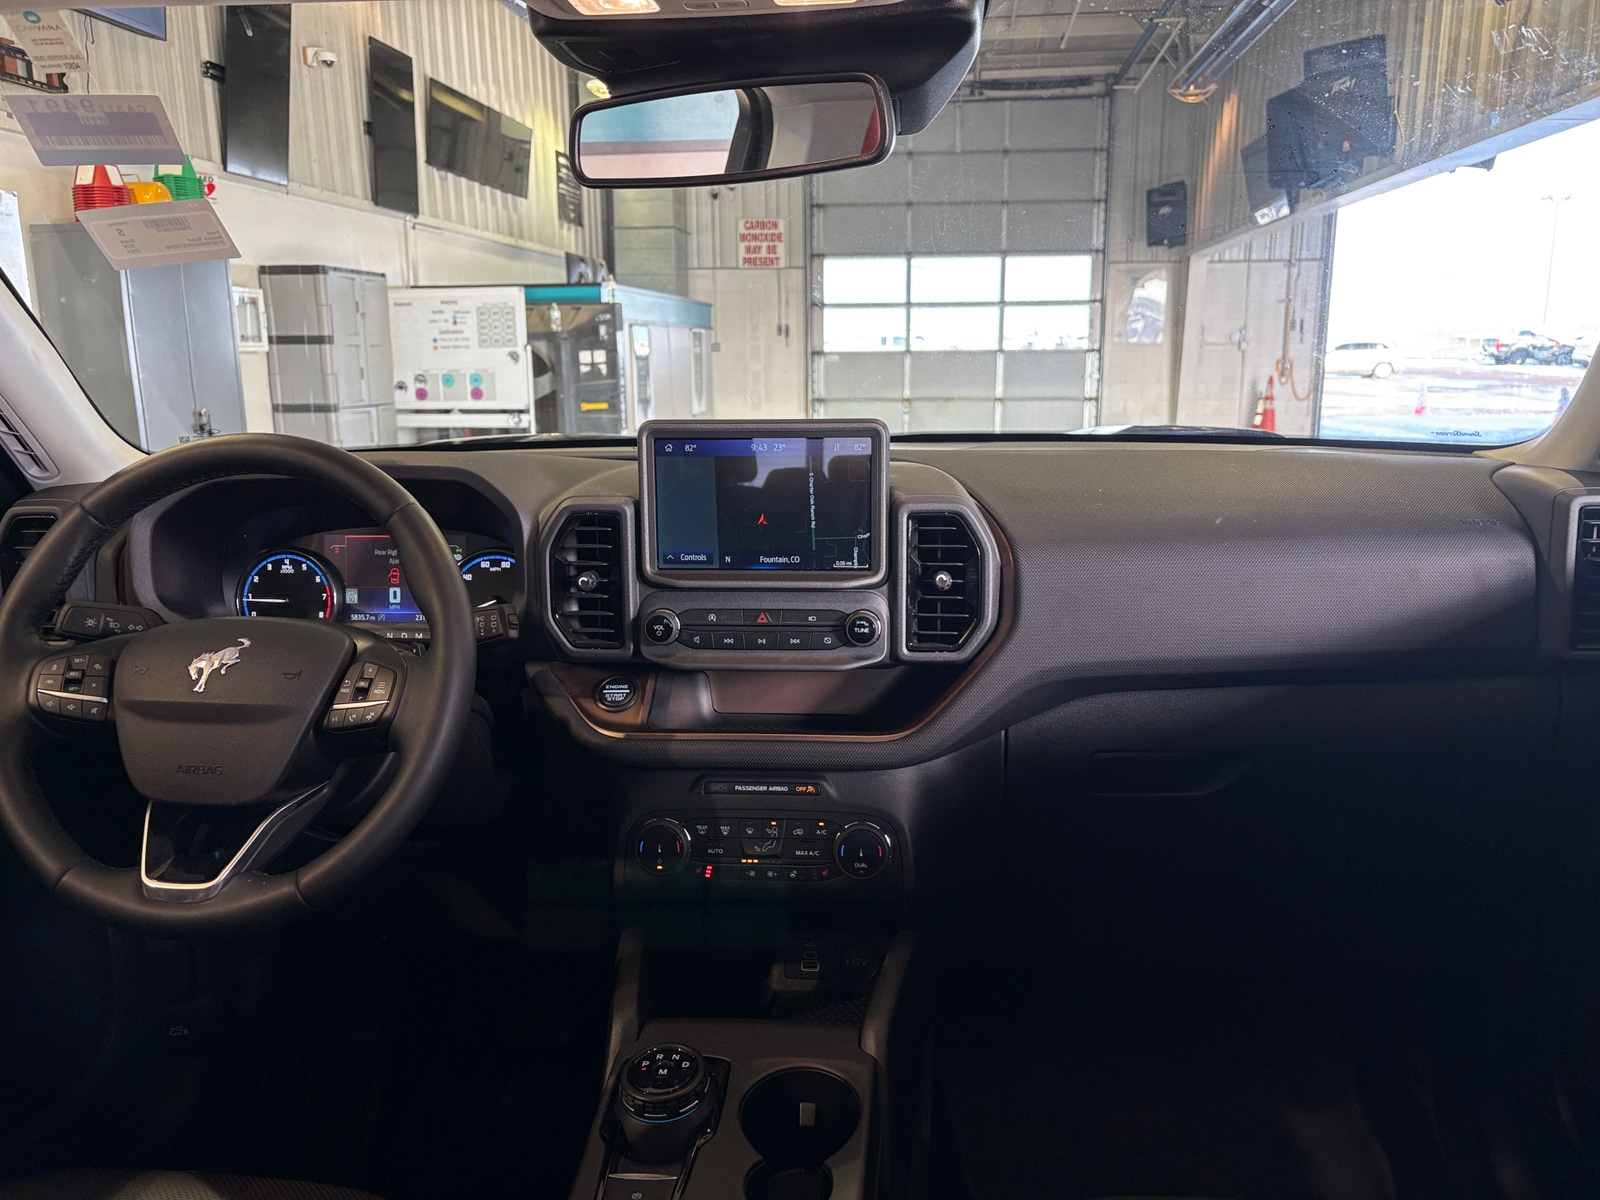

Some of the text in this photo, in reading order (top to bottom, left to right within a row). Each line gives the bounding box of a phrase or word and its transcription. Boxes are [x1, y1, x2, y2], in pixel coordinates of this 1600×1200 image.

[743, 220, 779, 231] CARBON
[739, 232, 783, 243] MONOXIDE
[744, 244, 778, 255] MAY BE
[742, 256, 780, 267] PRESENT
[751, 444, 768, 452] 9:43
[680, 553, 707, 561] Controls
[725, 555, 800, 564] N Fountain, CO
[389, 587, 401, 603] 0
[176, 764, 223, 776] AIRBAG
[734, 784, 768, 792] PASSENGER
